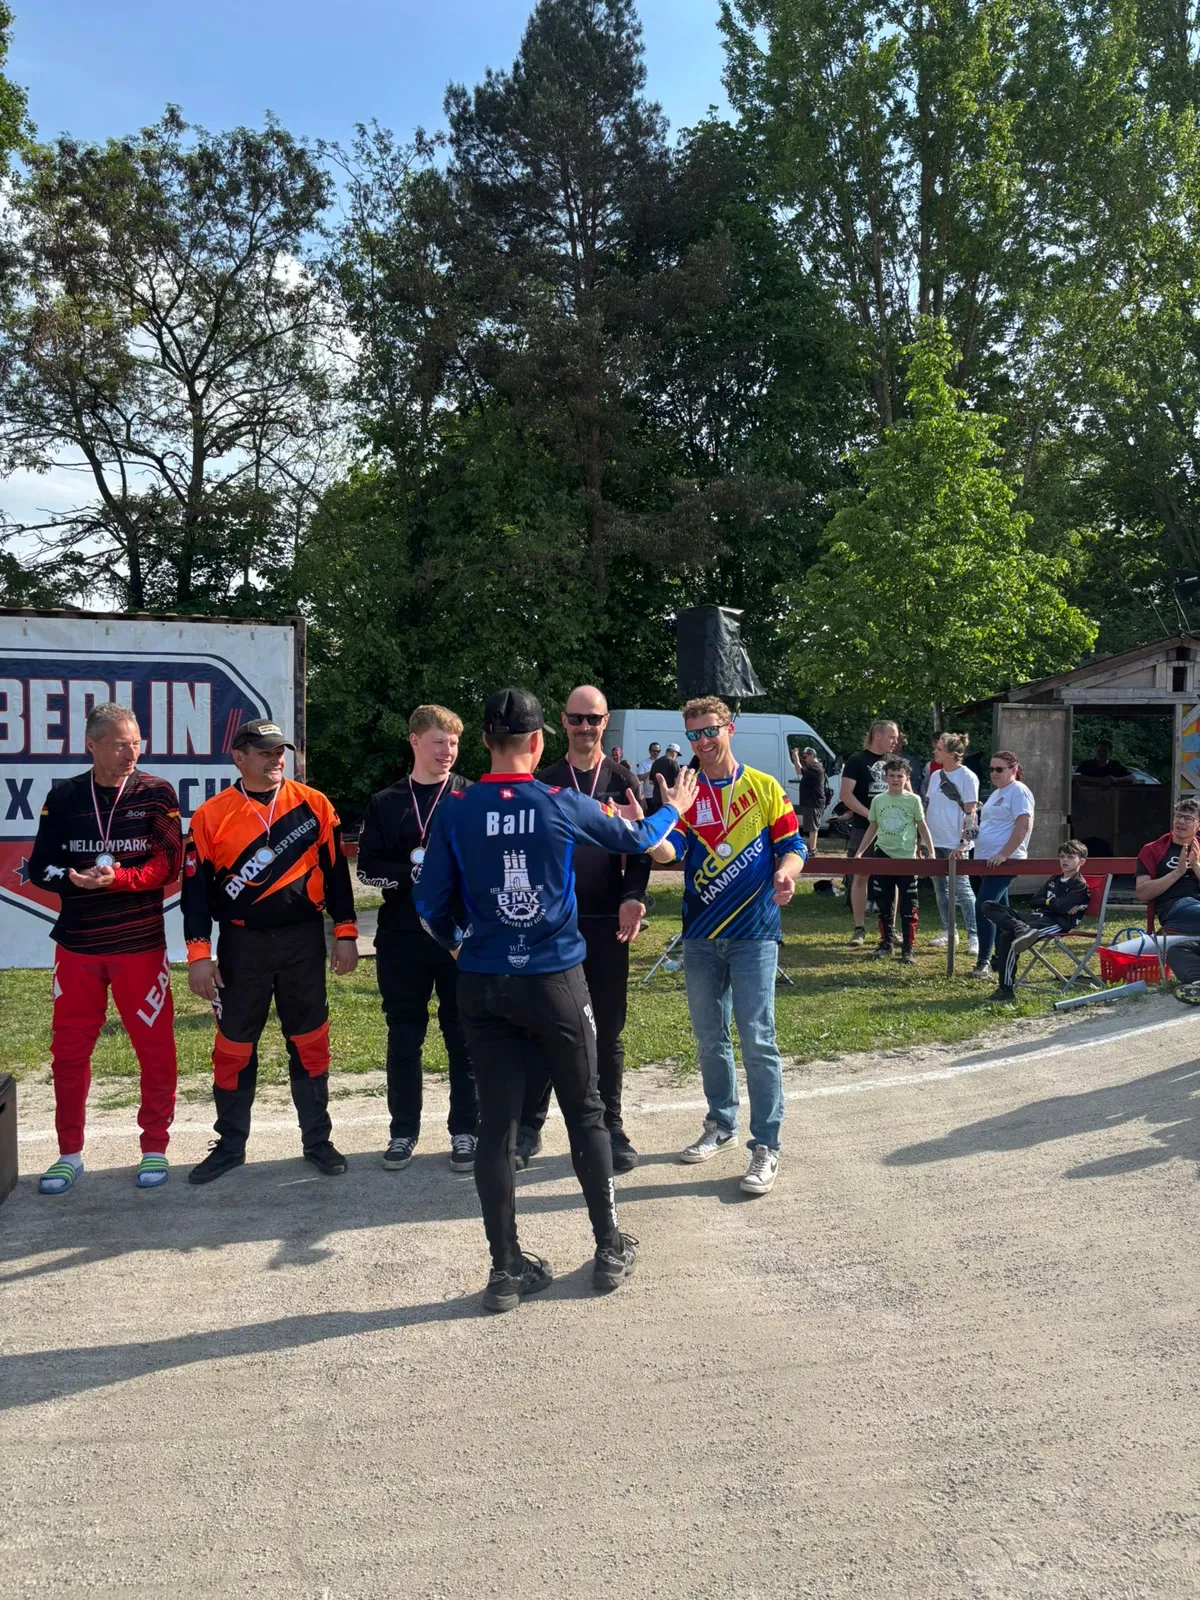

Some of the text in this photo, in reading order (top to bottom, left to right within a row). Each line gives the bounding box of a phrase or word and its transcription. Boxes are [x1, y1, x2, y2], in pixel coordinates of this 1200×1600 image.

[486, 808, 535, 837] Ball
[700, 838, 763, 905] HAMBURG
[497, 891, 540, 906] BMX
